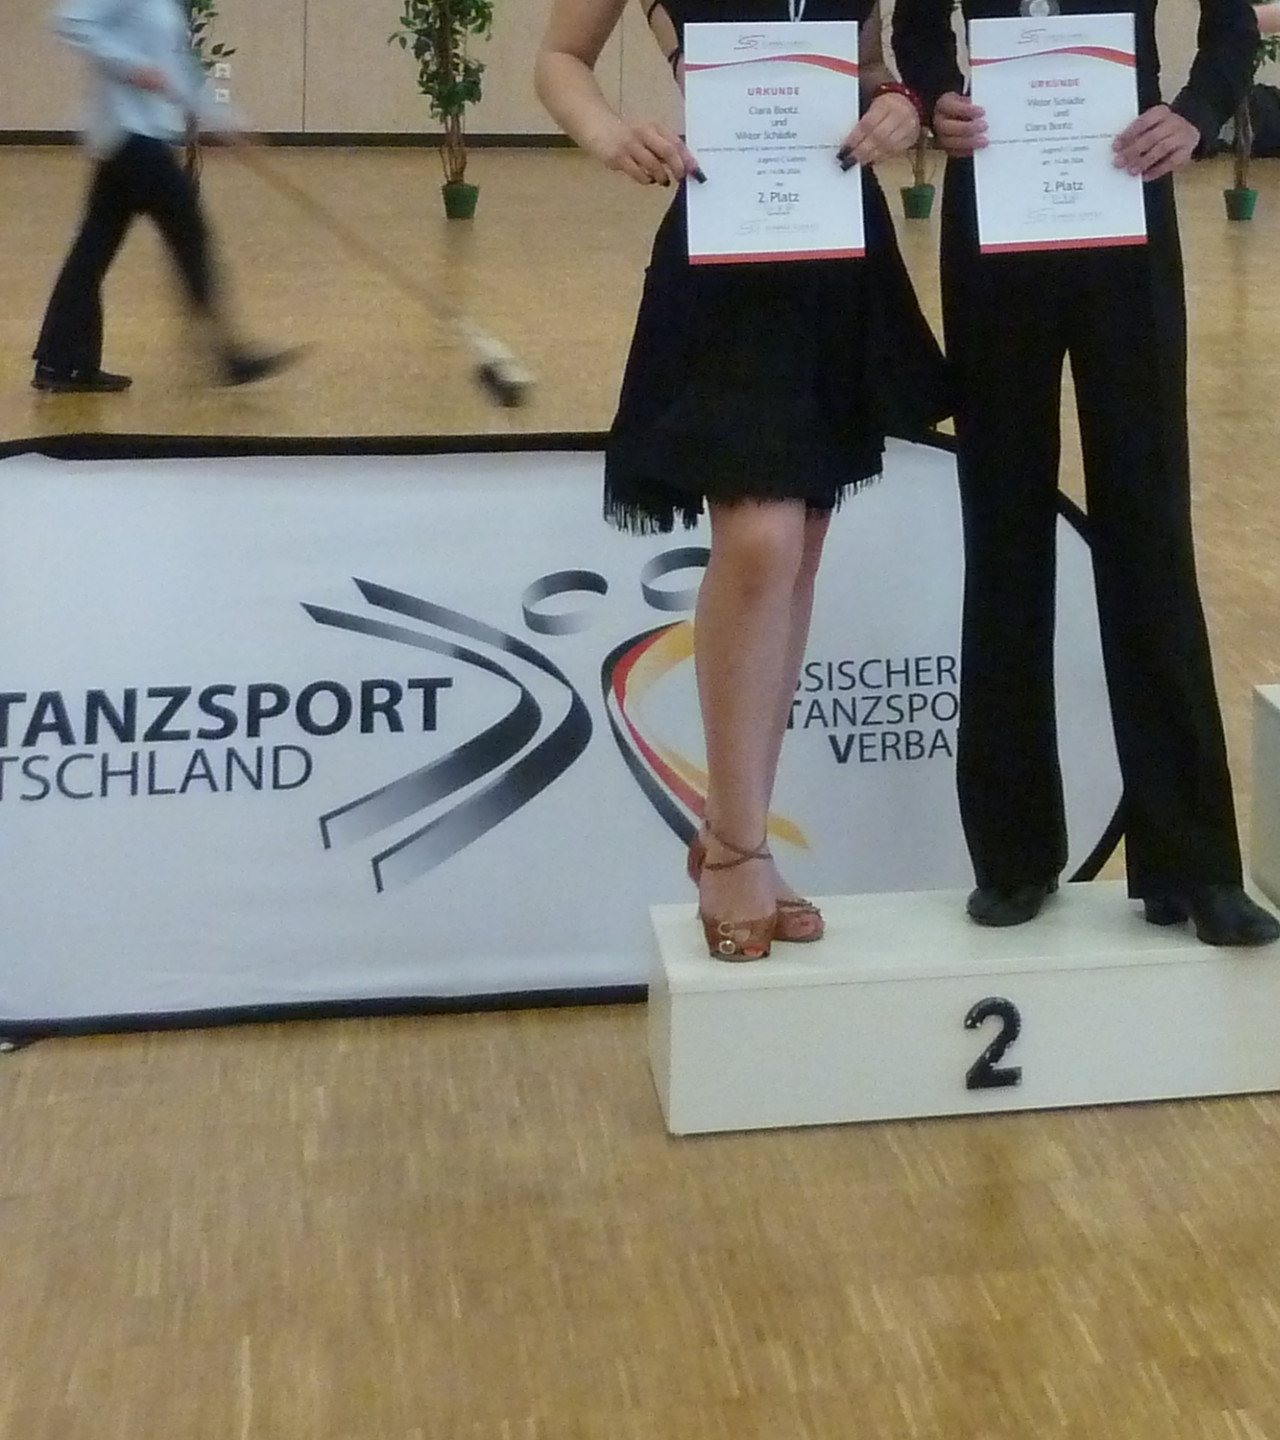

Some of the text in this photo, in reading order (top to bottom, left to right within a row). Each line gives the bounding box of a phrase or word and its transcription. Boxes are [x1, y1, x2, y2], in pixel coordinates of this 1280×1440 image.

[1031, 78, 1080, 89] URKUNDE
[747, 87, 800, 96] URKUNDE
[749, 106, 772, 115] Clara
[1054, 110, 1069, 118] und
[771, 118, 787, 127] und
[1025, 123, 1047, 132] Clara
[735, 132, 761, 140] Viktor
[1043, 180, 1084, 193] 2. Platz
[758, 191, 800, 203] 2. Platz
[0, 677, 453, 748] TANZSPORT
[964, 997, 1021, 1089] 2
